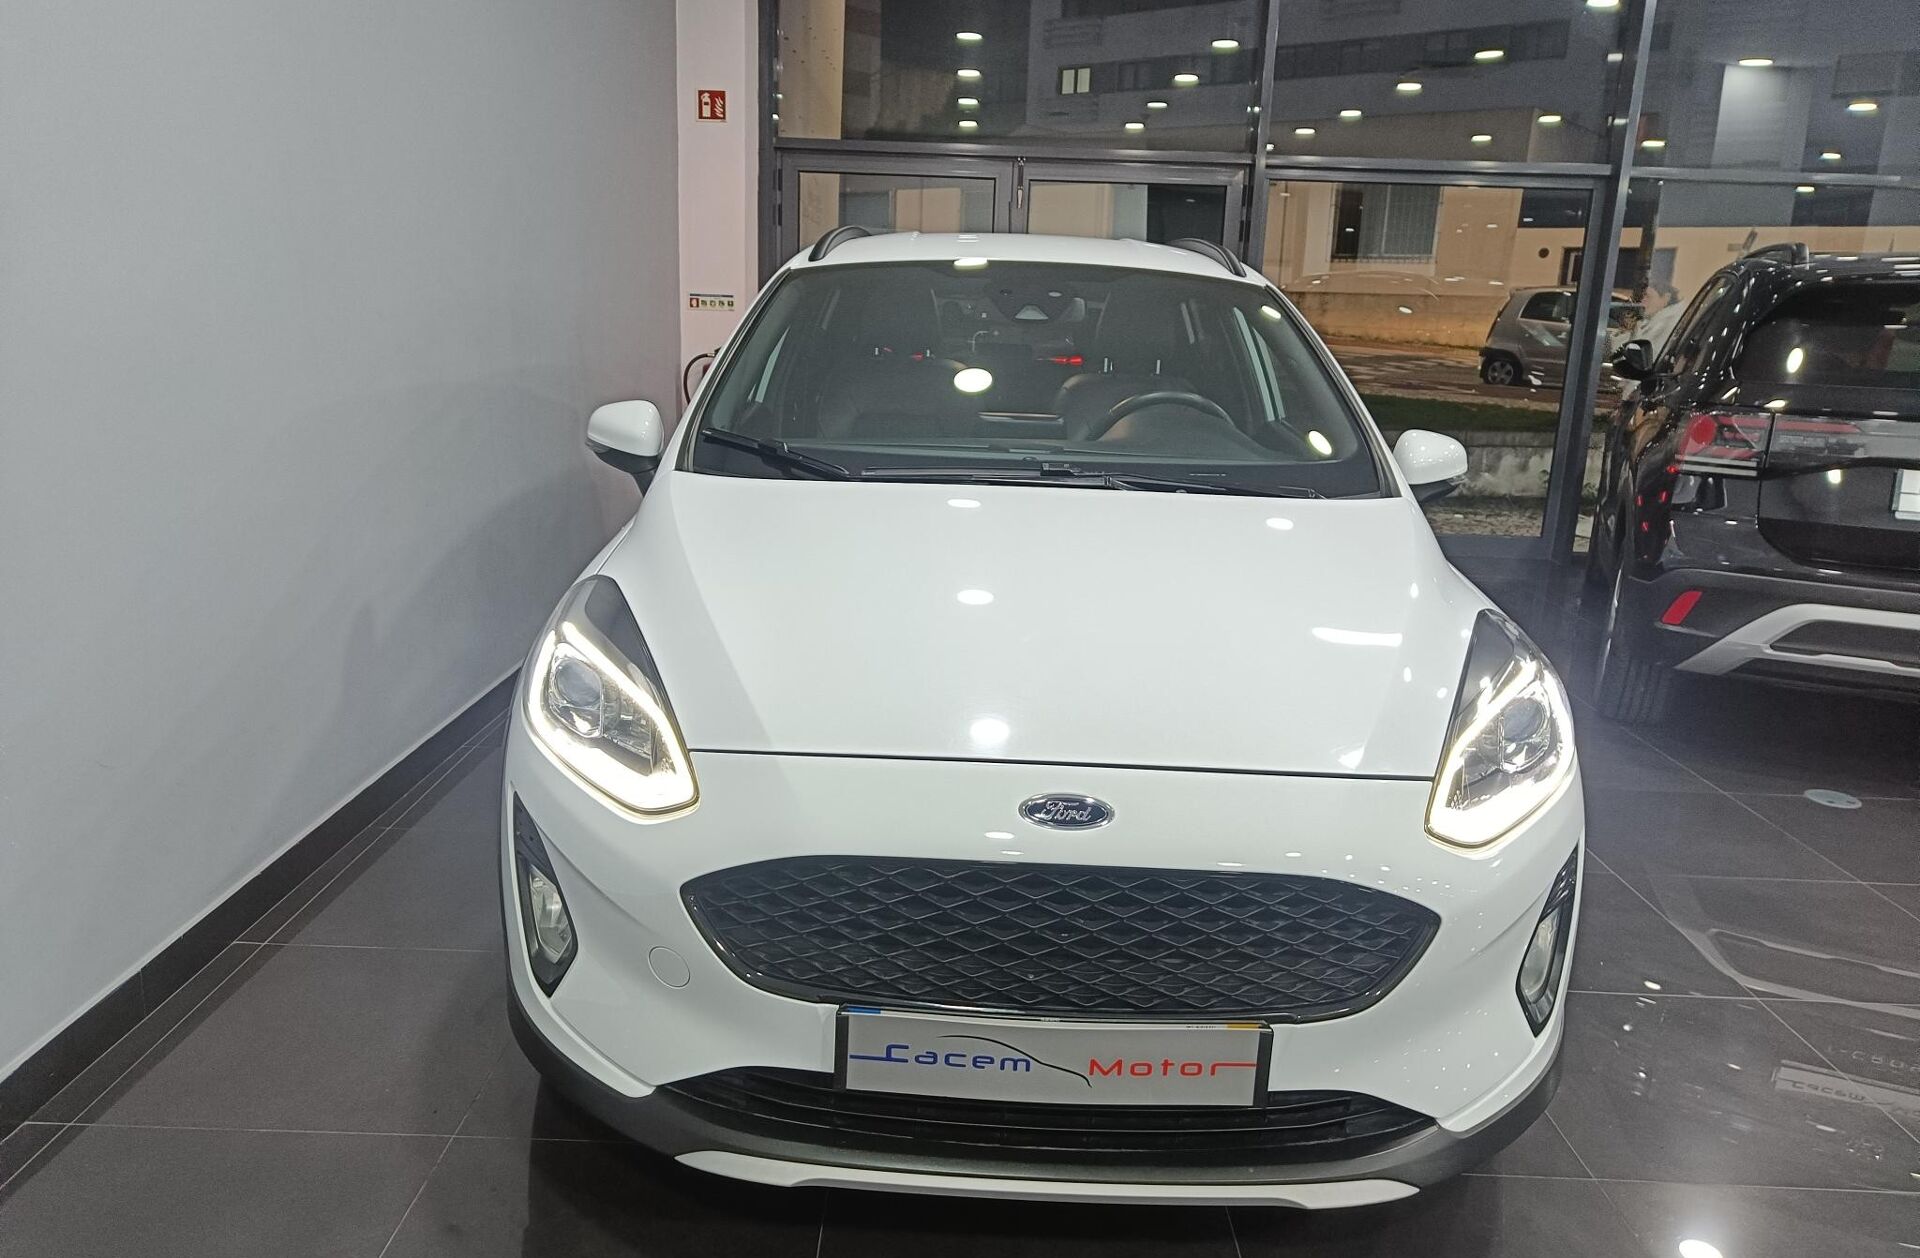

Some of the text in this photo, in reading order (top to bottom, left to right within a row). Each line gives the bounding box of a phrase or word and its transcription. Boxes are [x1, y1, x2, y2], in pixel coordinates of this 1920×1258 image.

[1041, 800, 1092, 821] Ford
[849, 1044, 1257, 1077] Cacem Motor
